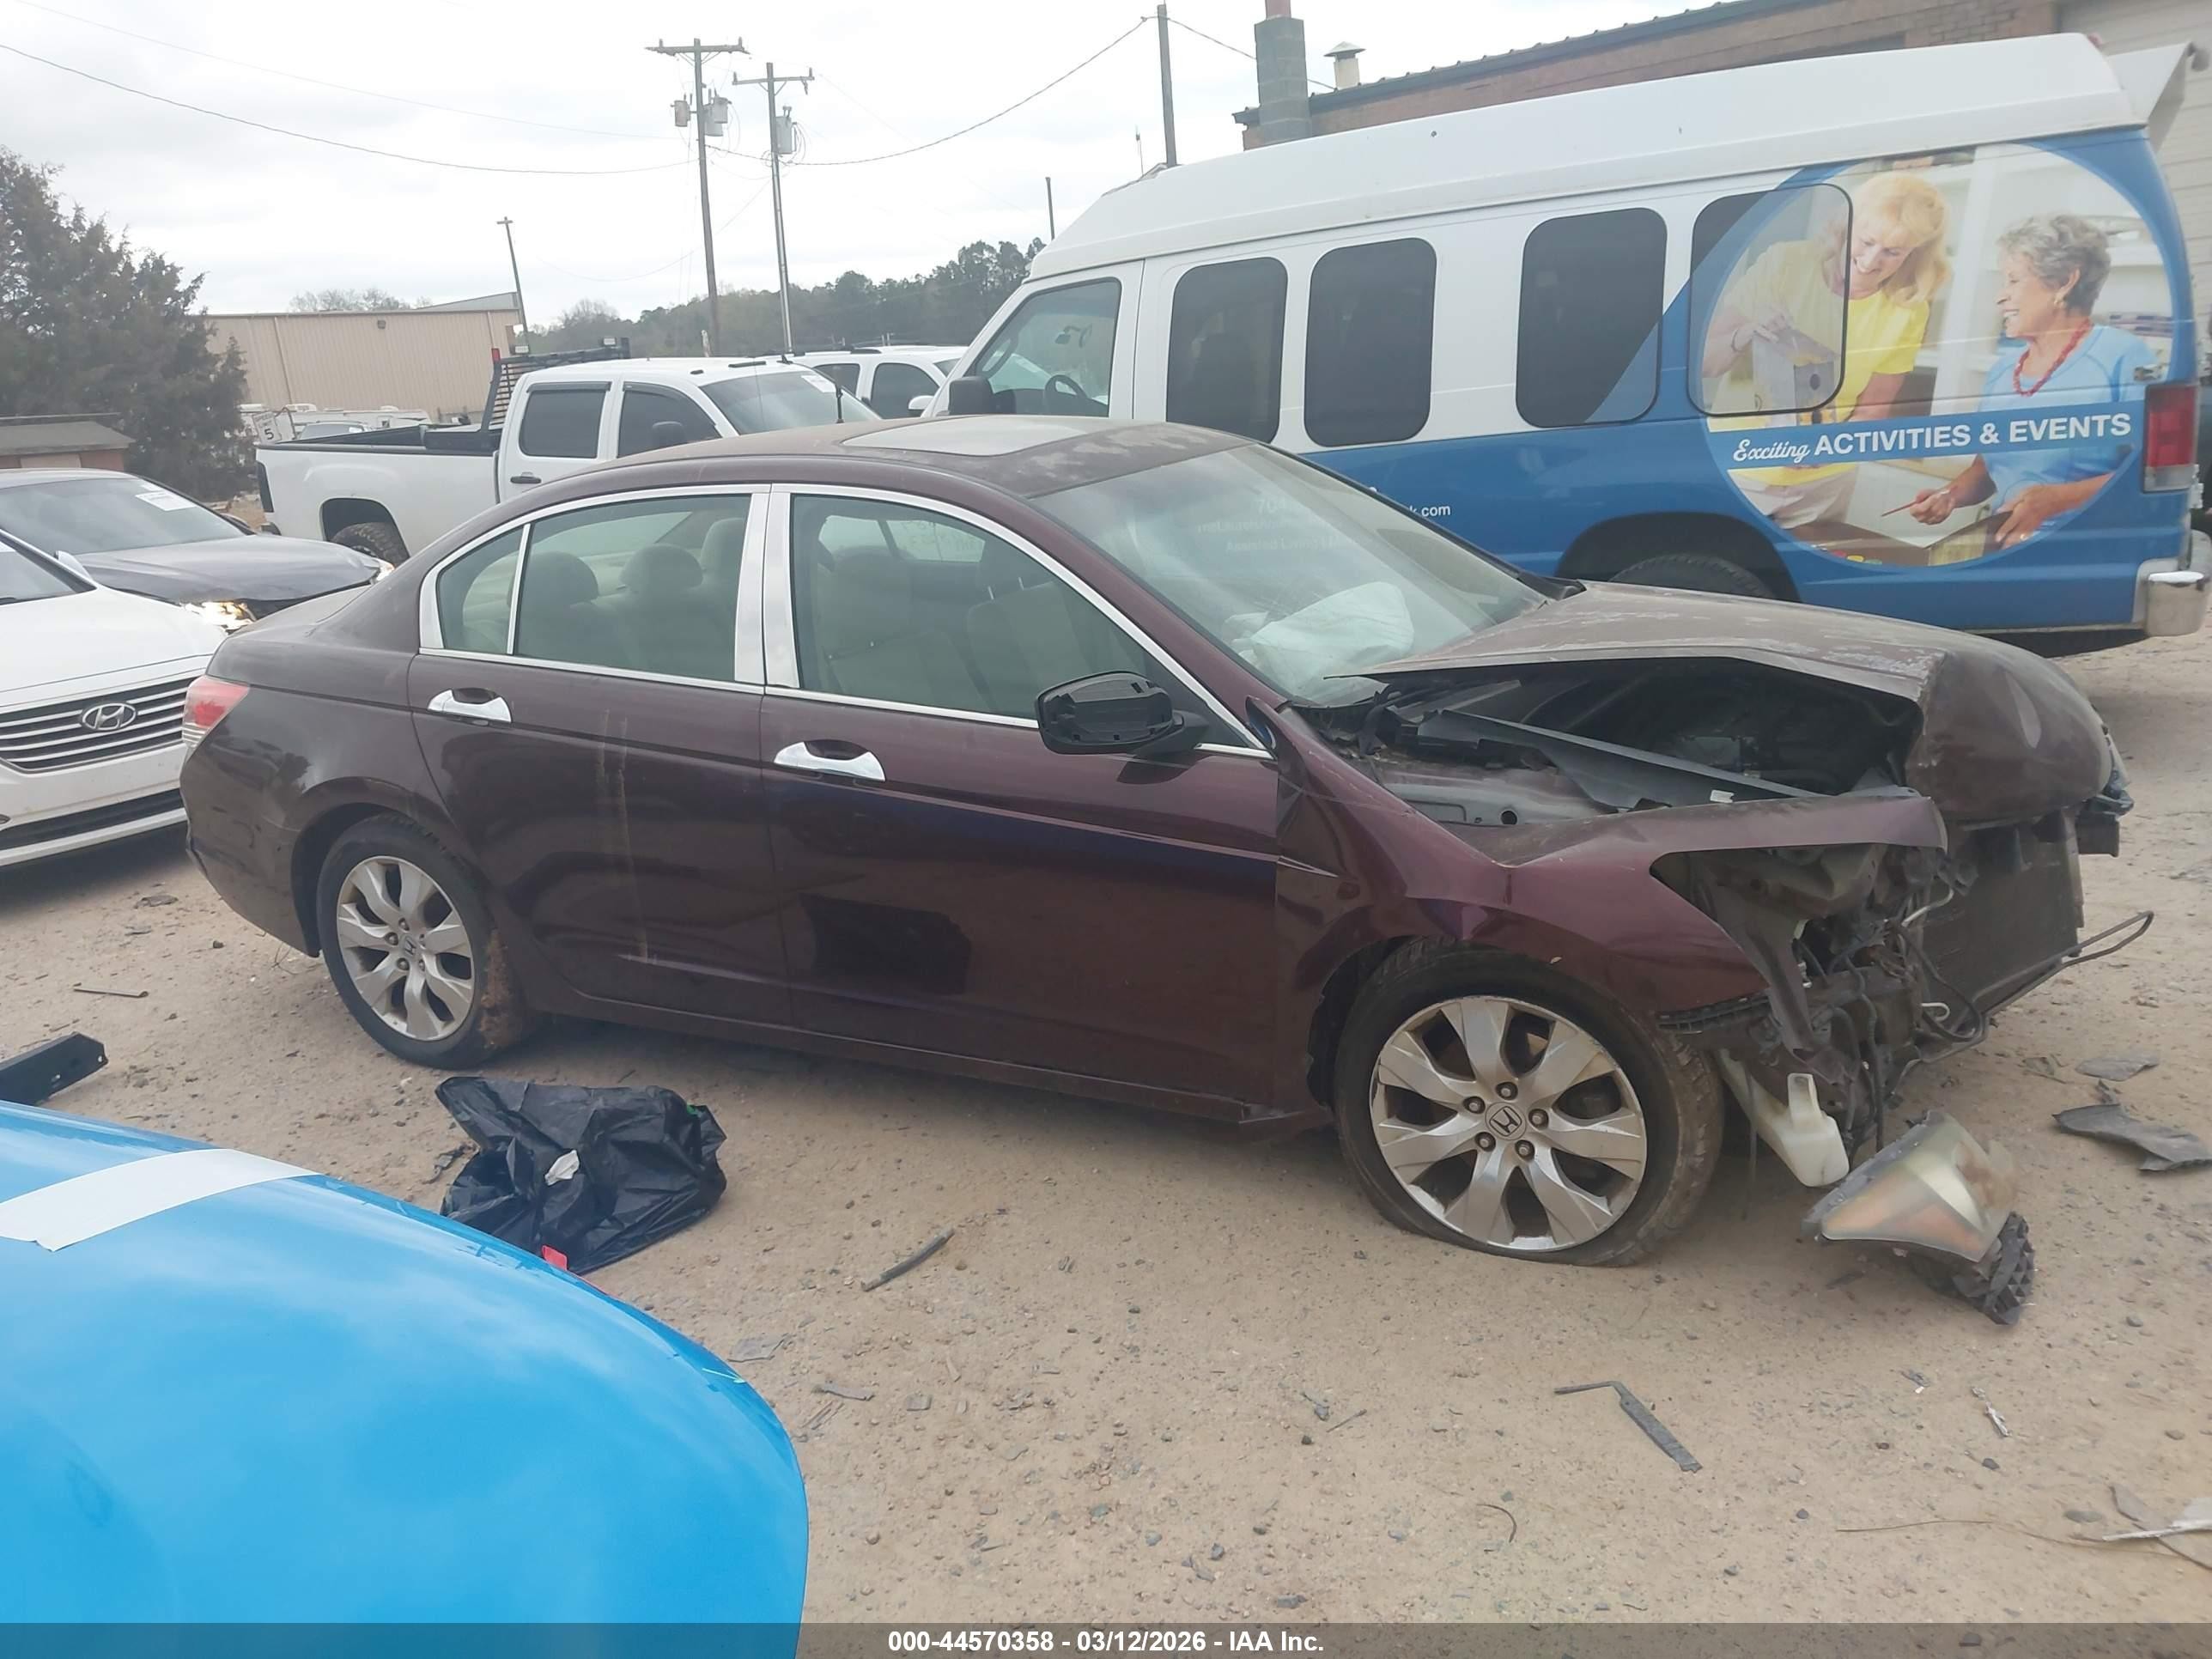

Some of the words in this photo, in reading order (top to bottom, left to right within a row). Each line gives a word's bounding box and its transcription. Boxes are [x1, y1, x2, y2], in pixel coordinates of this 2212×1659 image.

[264, 428, 274, 440] 5
[1733, 439, 1812, 464] Exciting
[1814, 424, 1972, 457] ACTIVITIES
[1979, 422, 2000, 445] &
[2009, 412, 2131, 443] EVENTS
